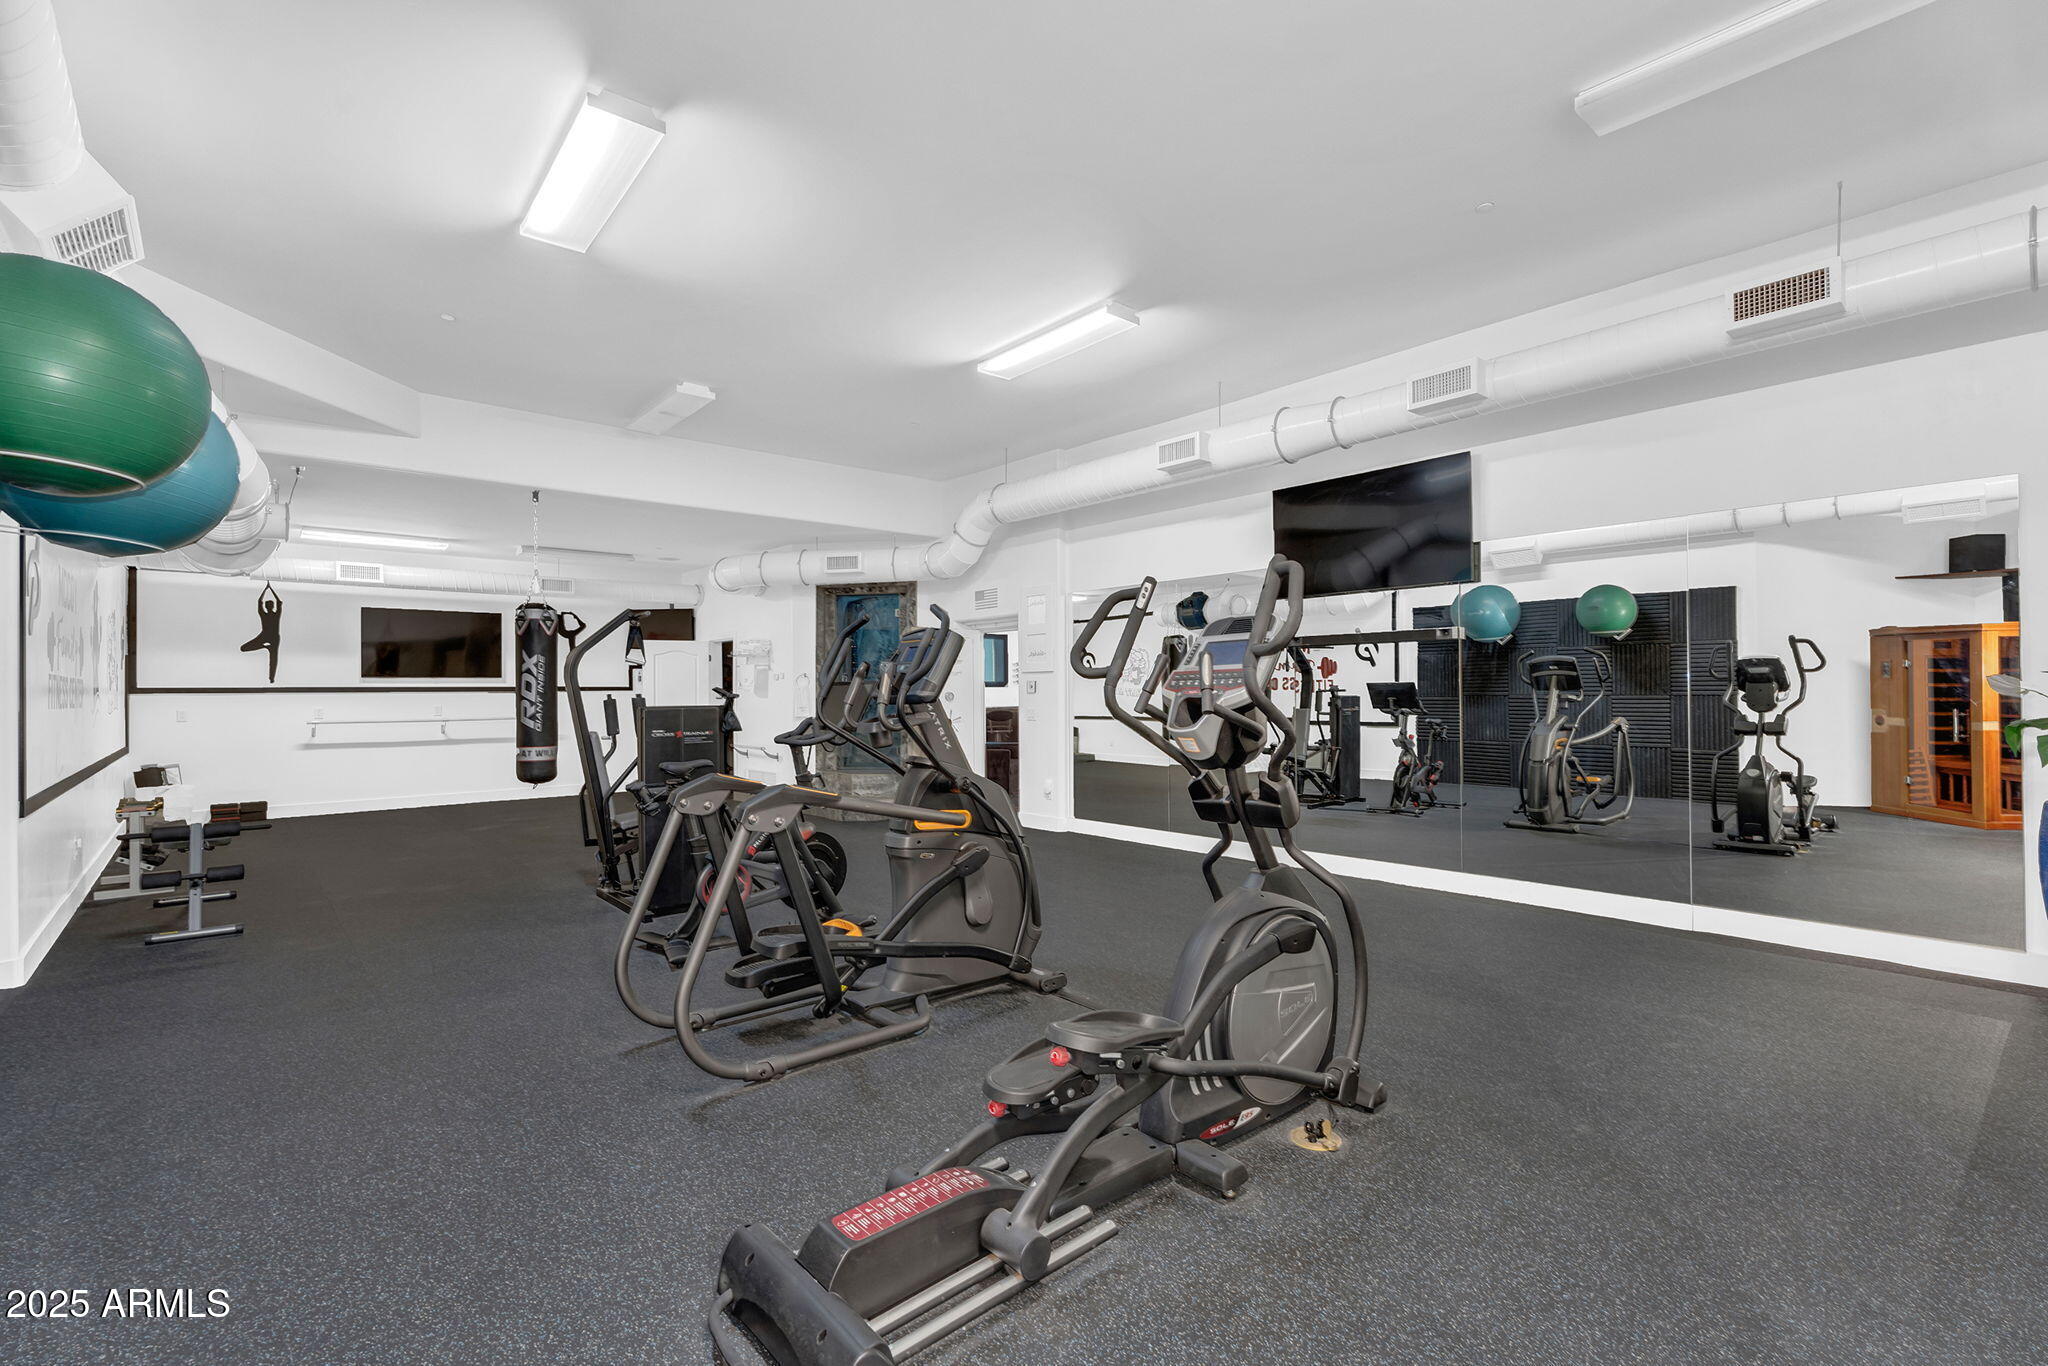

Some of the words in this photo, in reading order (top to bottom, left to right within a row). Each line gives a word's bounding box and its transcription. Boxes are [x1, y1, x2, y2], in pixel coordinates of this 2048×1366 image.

[521, 649, 538, 729] RDX
[536, 654, 546, 694] INSIDE
[534, 695, 544, 732] GIANT
[927, 703, 952, 750] MATRIX
[1210, 1119, 1235, 1134] SOLE
